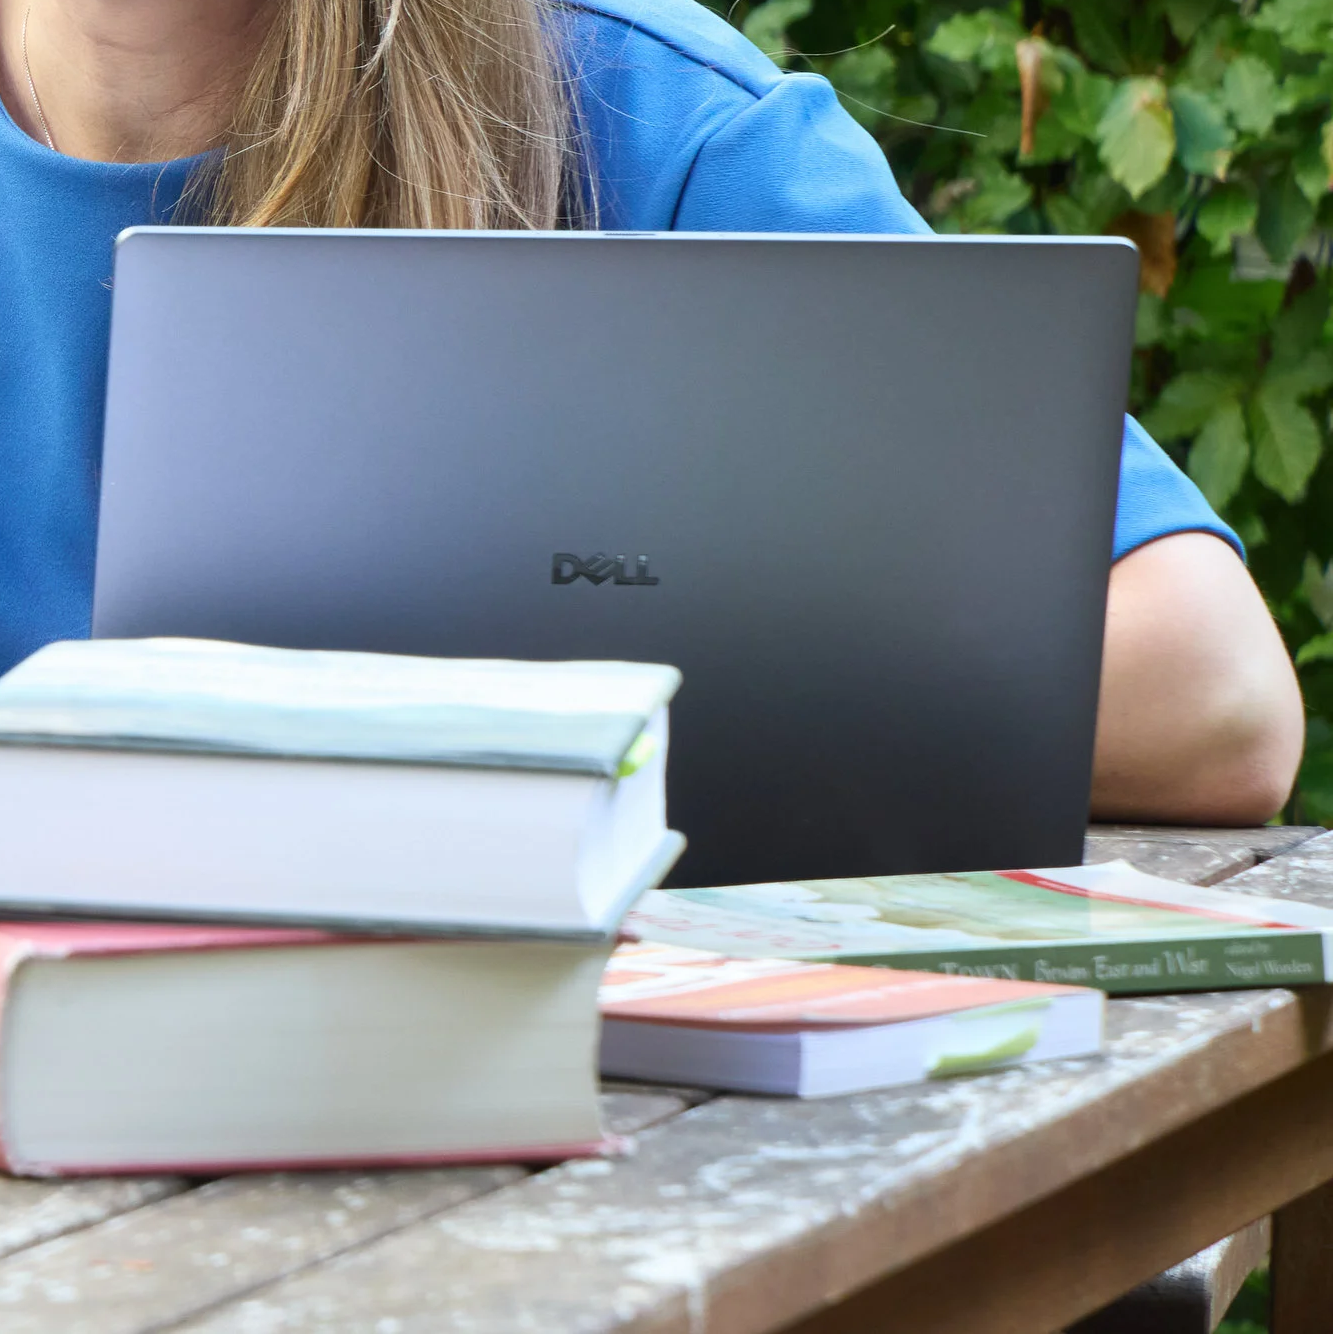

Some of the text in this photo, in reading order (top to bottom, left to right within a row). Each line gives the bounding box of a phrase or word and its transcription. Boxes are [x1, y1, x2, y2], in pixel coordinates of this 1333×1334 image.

[551, 552, 660, 587] DELL
[1092, 955, 1129, 980] East
[1132, 958, 1161, 976] and
[1162, 946, 1209, 976] West
